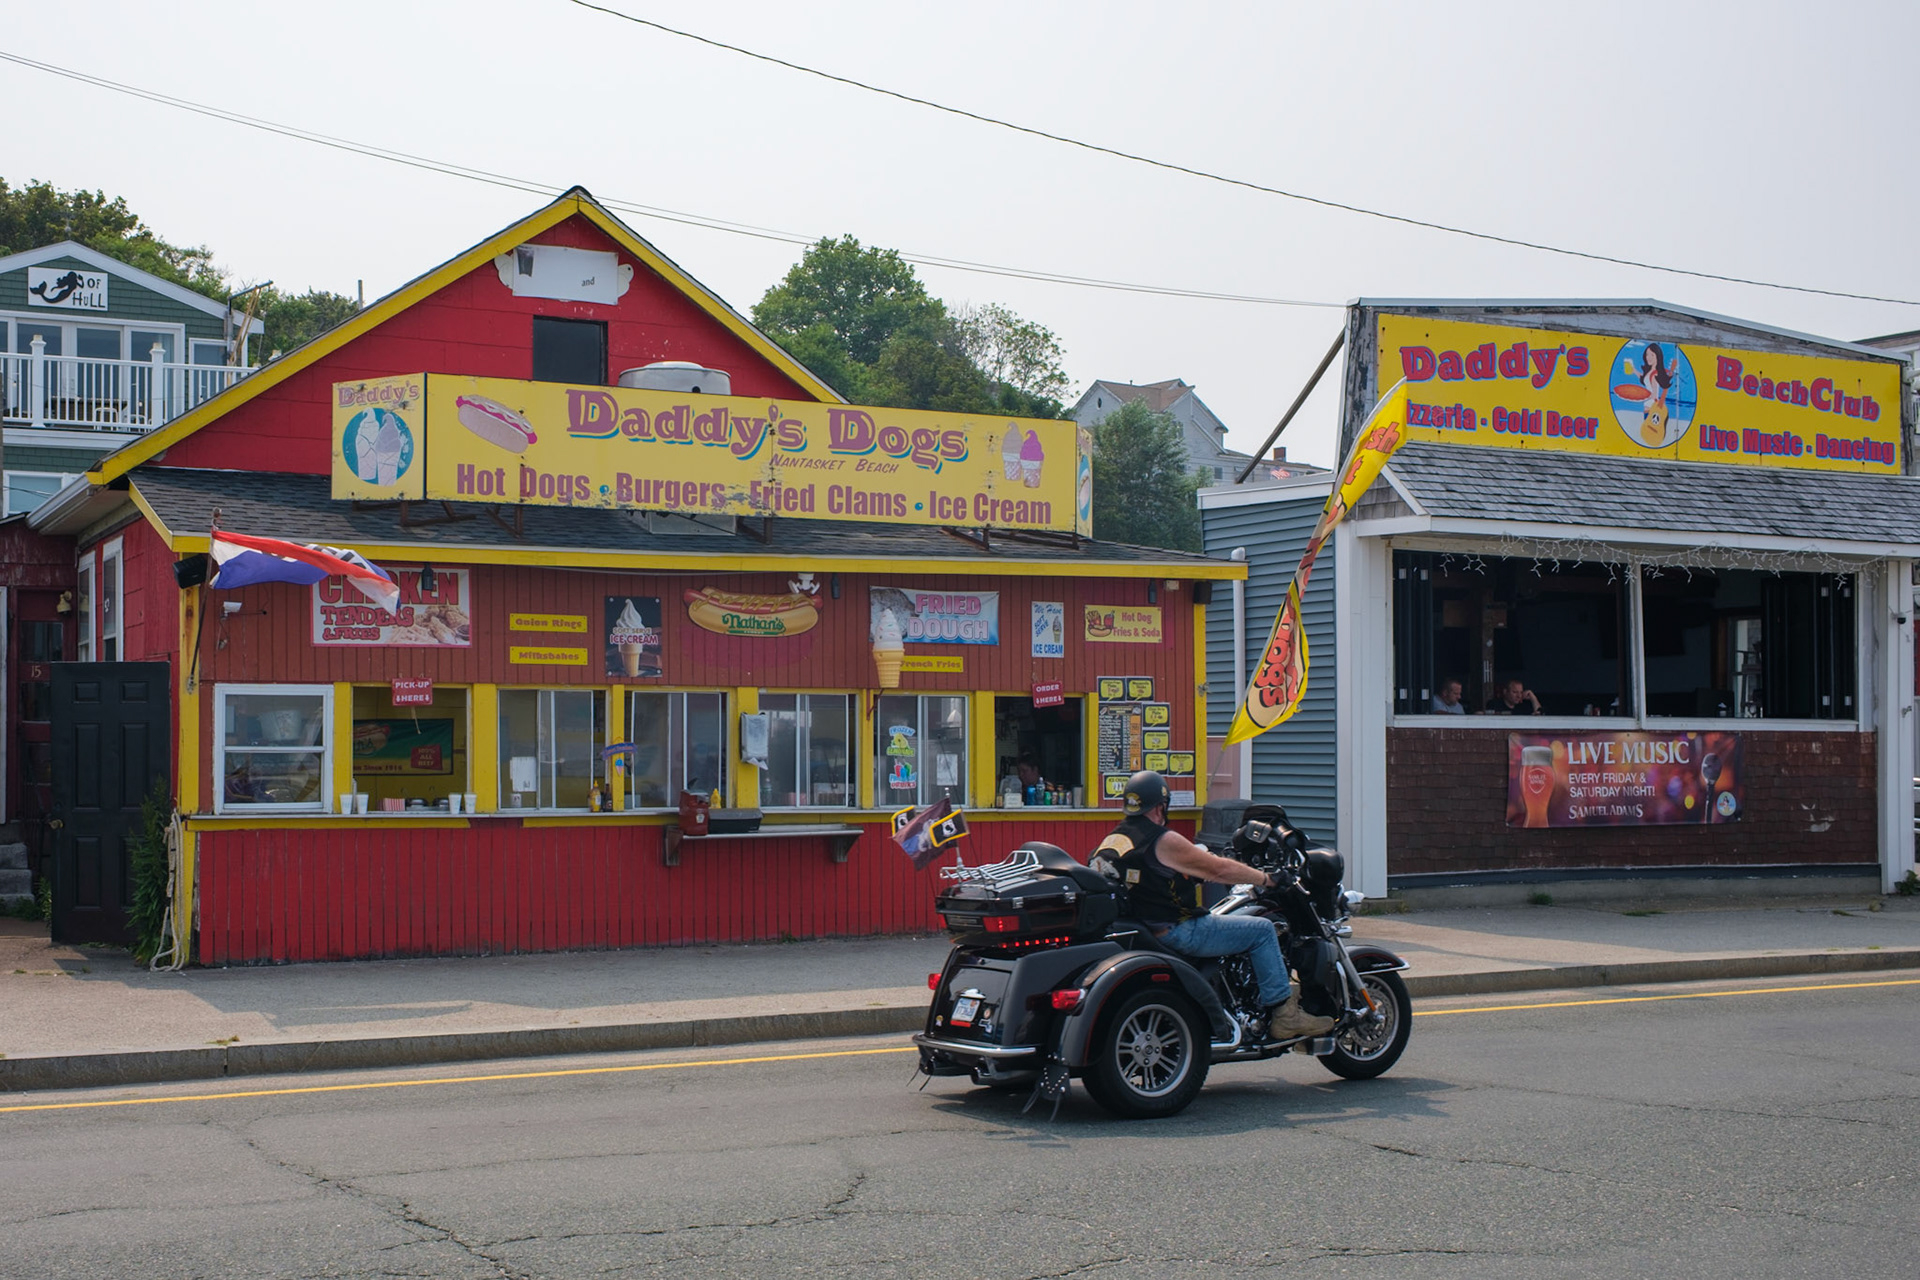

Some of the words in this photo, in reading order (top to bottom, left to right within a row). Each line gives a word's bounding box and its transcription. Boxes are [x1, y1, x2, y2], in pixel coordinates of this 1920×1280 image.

[581, 276, 596, 287] and
[1400, 342, 1590, 389] Daddy's
[338, 380, 420, 407] Daddy's
[1406, 400, 1476, 431] izzeria
[1492, 405, 1544, 435] Cold
[1547, 410, 1599, 439] Beer
[566, 388, 807, 460] Daddy's
[827, 408, 969, 474] Dogs
[1700, 424, 1738, 453] Live
[1743, 428, 1803, 457] Music
[1816, 434, 1895, 465] Dancing
[770, 454, 846, 471] NANTASKET
[855, 458, 900, 474] BEACH
[457, 463, 506, 497] Hot
[519, 465, 590, 501] Dogs
[615, 472, 726, 509] Burgers
[750, 480, 815, 514] Fried
[828, 484, 907, 517] Clams
[929, 491, 967, 520] Ice
[974, 493, 1051, 525] Cream
[915, 594, 982, 615] FRIED
[320, 605, 414, 627] TENDERS
[1121, 612, 1136, 623] Hot
[1137, 613, 1152, 624] Dog
[515, 618, 548, 627] Onion
[552, 619, 582, 629] Rings
[722, 613, 786, 633] Nathan's
[908, 618, 989, 641] DOUGH
[1113, 627, 1132, 637] Fries
[1133, 628, 1139, 637] &
[1141, 627, 1160, 637] Soda
[610, 634, 625, 645] ICE
[626, 634, 658, 645] CREAM
[1033, 644, 1043, 654] ICE
[1044, 644, 1063, 654] CREAM
[519, 651, 579, 661] Milkshakes
[31, 665, 41, 678] 15
[936, 661, 961, 669] Fries
[395, 681, 430, 689] PICK-UP
[1036, 683, 1060, 693] ORDER
[401, 694, 424, 702] HERE
[1040, 696, 1058, 704] HERE
[1567, 741, 1616, 765] LIVE
[1622, 740, 1690, 765] MUSIC
[1568, 772, 1601, 784] EVERY
[1603, 772, 1637, 784] FRIDAY
[1639, 773, 1646, 783] &
[1569, 786, 1620, 798] SATURDAY
[1622, 785, 1656, 797] NIGHT!
[1568, 804, 1608, 819] SAMUEL
[1610, 803, 1644, 817] ADAMS
